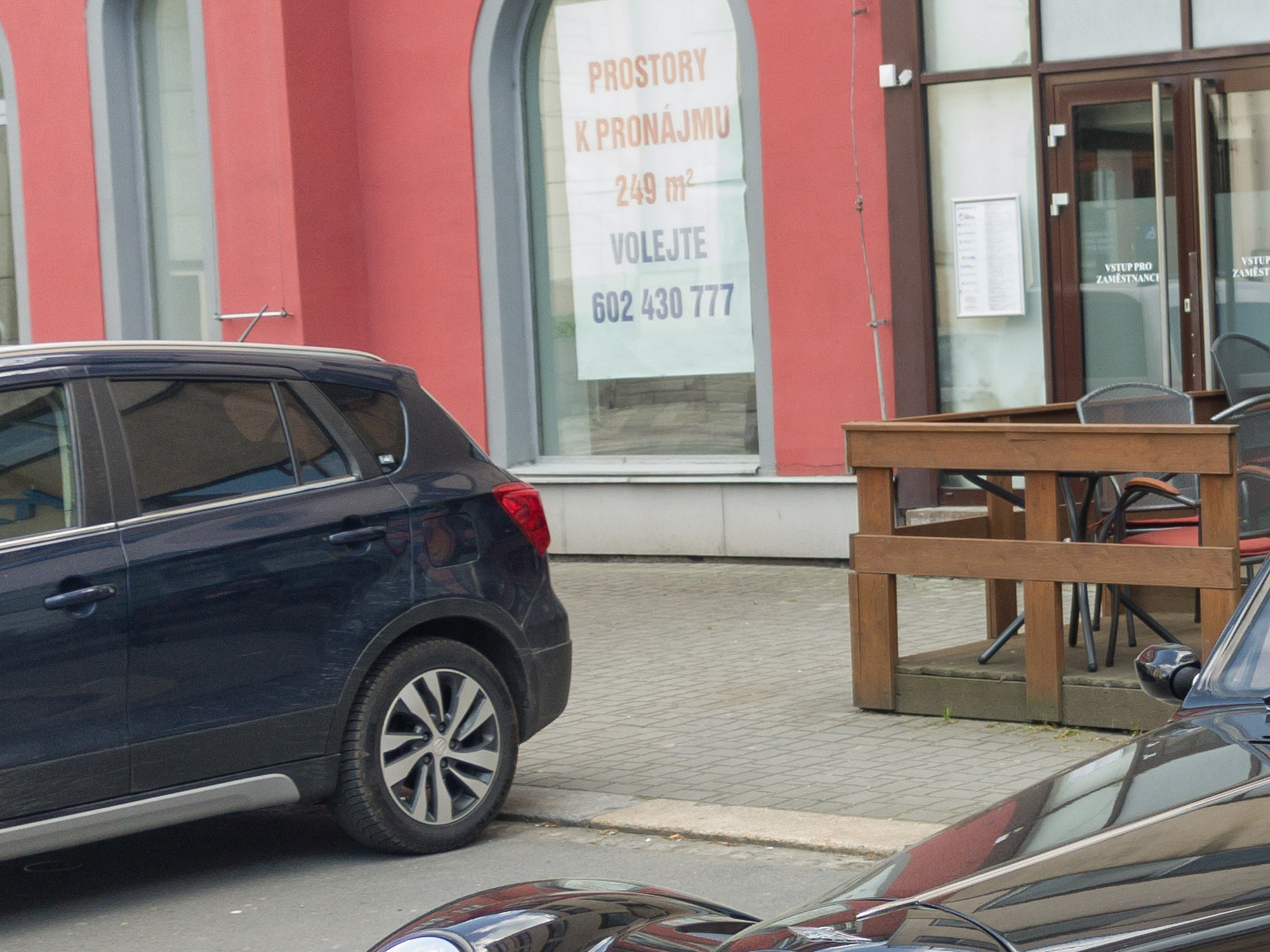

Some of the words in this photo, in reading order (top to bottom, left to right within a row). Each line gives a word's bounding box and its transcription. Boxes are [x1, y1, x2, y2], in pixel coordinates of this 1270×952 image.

[588, 47, 708, 94] PROSTORY
[575, 120, 591, 153] K
[595, 104, 731, 152] PRONÁJMU
[615, 171, 658, 208] 249
[610, 226, 708, 266] VOLEJTE
[1104, 263, 1133, 272] VSTUP
[1133, 261, 1153, 272] PRO
[591, 290, 634, 324] 602
[641, 286, 684, 322] 430
[690, 283, 735, 318] 777
